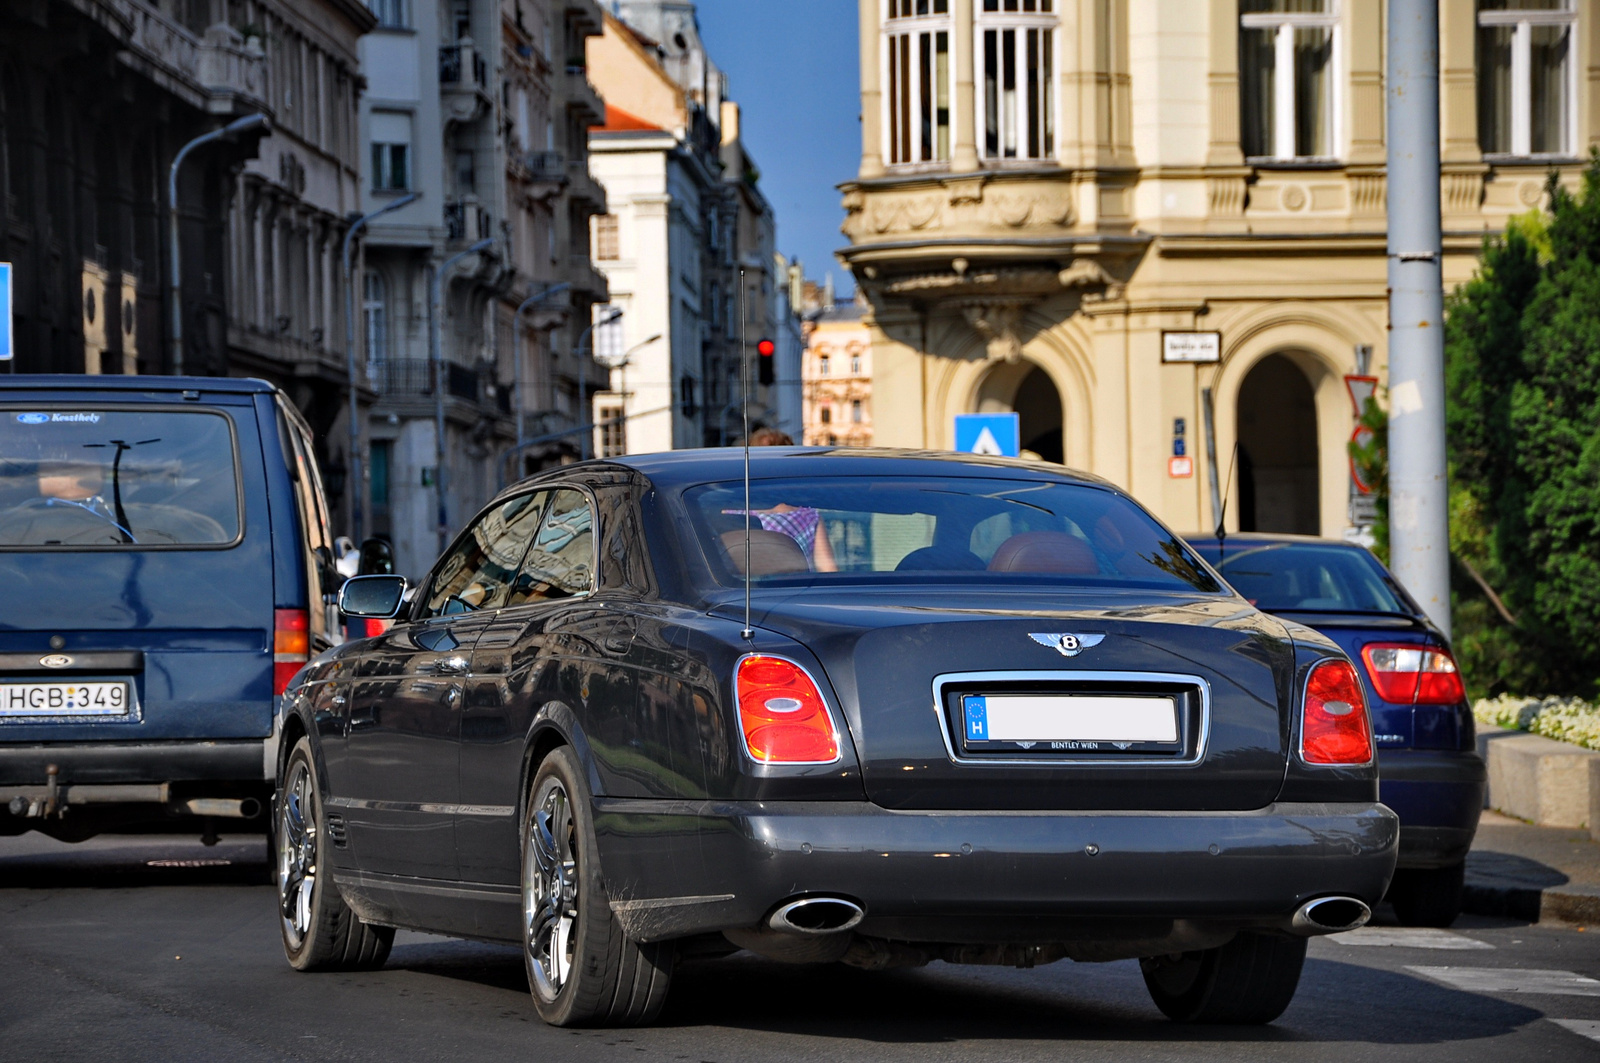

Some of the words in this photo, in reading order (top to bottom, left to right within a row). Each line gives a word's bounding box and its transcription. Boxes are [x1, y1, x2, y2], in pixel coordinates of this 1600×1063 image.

[1062, 635, 1077, 650] B
[972, 721, 983, 734] H
[1051, 741, 1080, 749] BENTLEY
[1081, 741, 1098, 749] WIEN
